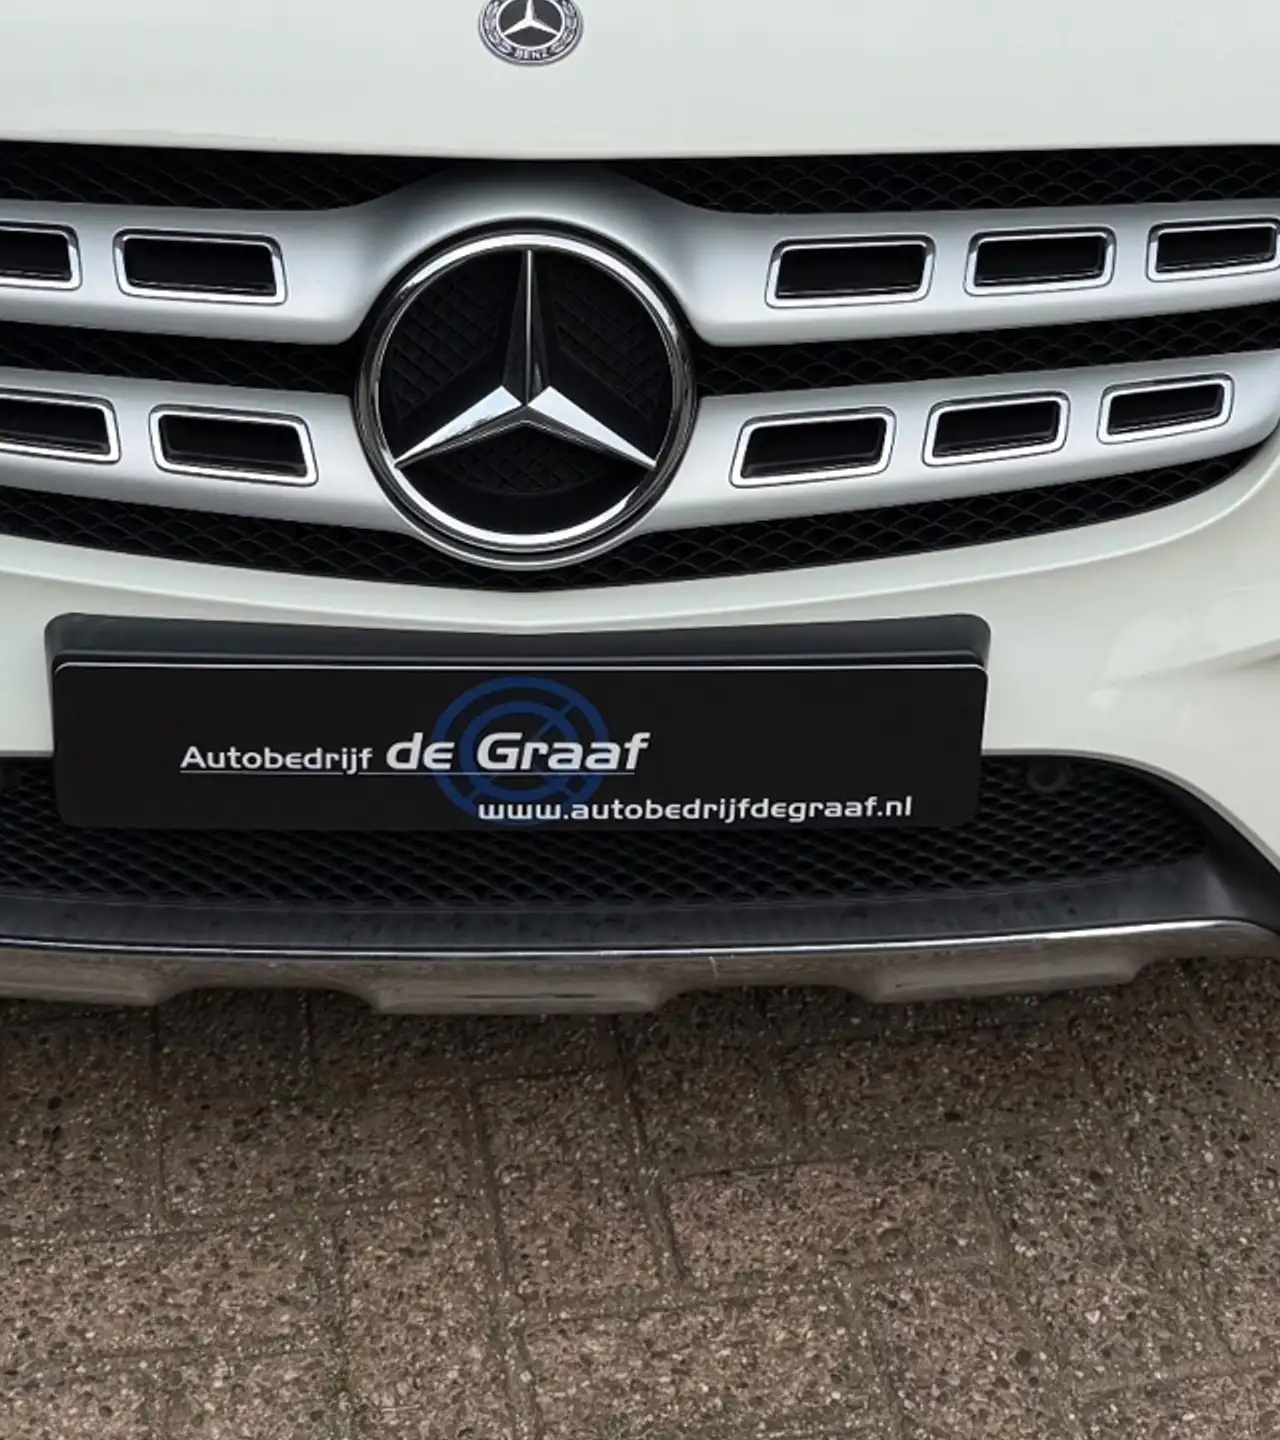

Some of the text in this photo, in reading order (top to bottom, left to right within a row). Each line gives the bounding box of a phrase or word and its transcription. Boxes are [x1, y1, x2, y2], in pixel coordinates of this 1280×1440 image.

[180, 732, 652, 776] Autobedrijf de Graaf
[477, 794, 913, 825] www.autobedrijfdegraaf.nl
